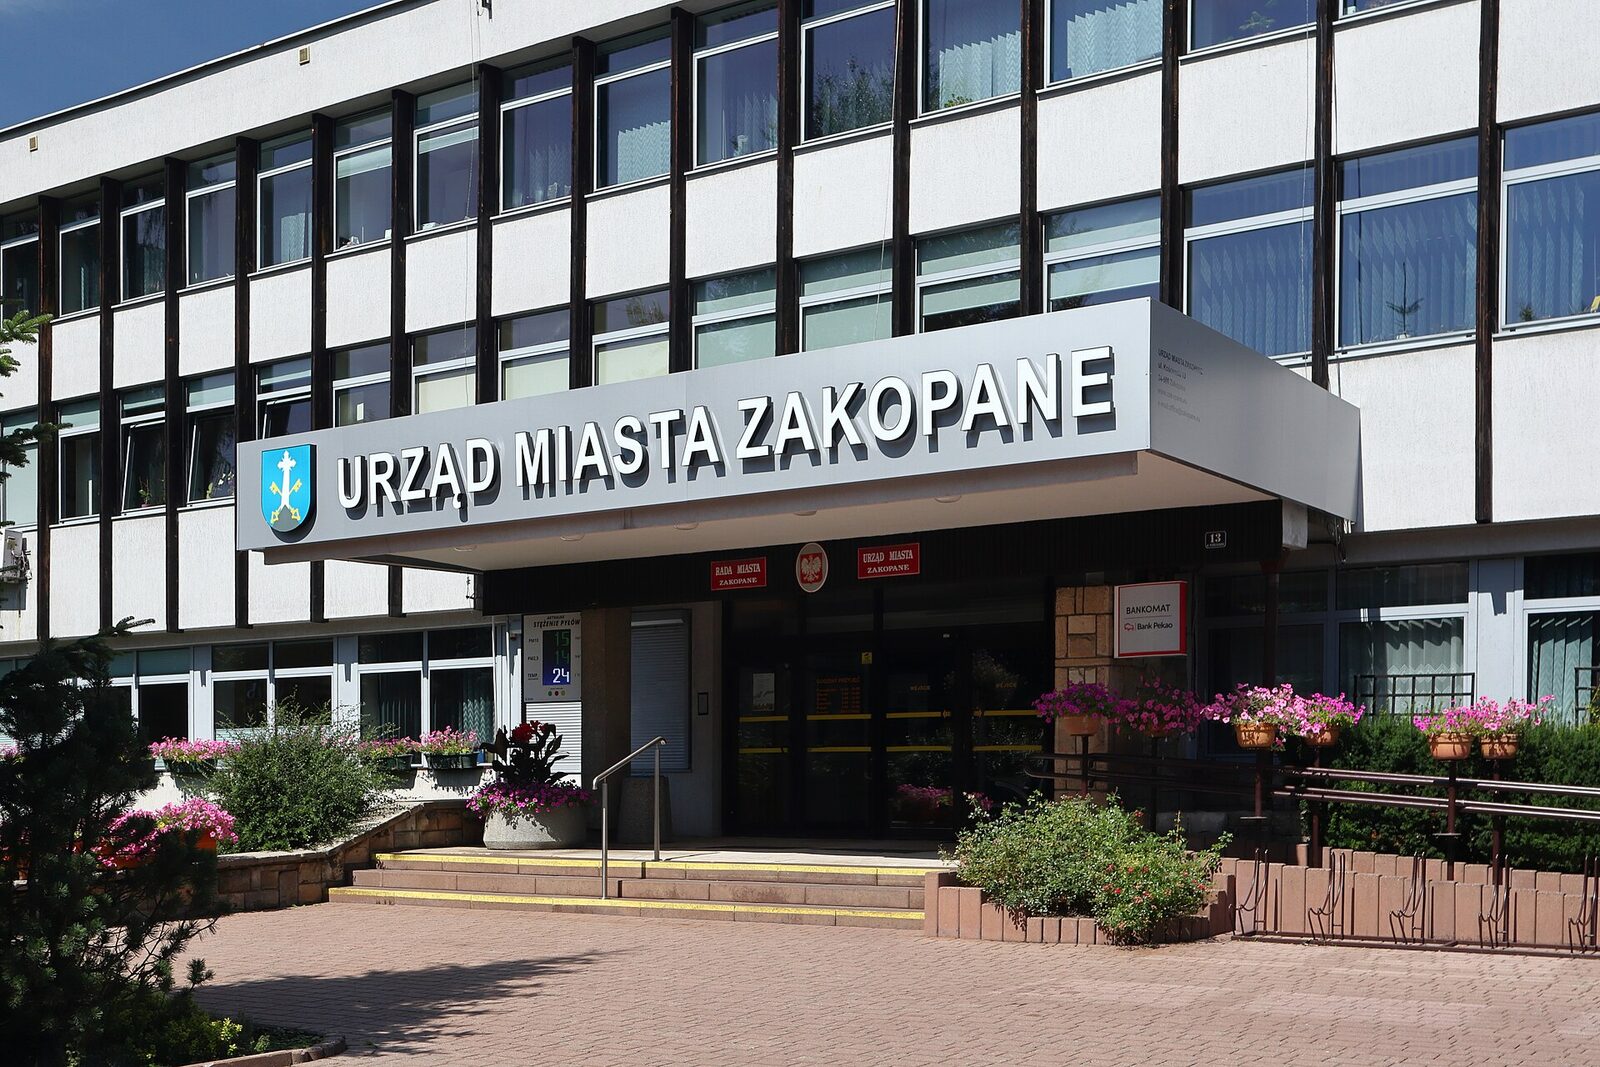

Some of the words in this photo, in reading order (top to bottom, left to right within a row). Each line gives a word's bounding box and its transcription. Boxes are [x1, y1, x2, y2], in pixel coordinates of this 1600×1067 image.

[337, 437, 496, 509] URZĄD
[515, 405, 721, 487] MIASTA
[735, 345, 1114, 459] ZAKOPANE
[1210, 533, 1221, 543] 13
[863, 551, 885, 564] URZĄD
[889, 549, 914, 561] MIASTA
[715, 566, 733, 576] RADA
[737, 563, 761, 575] MIASTA
[867, 564, 910, 574] ZAKOPANE
[719, 577, 758, 586] ZAKOPANE
[1126, 604, 1171, 615] BANKOMAT
[1137, 622, 1152, 630] Bank
[1153, 621, 1173, 629] Pekao
[553, 668, 569, 683] 24
